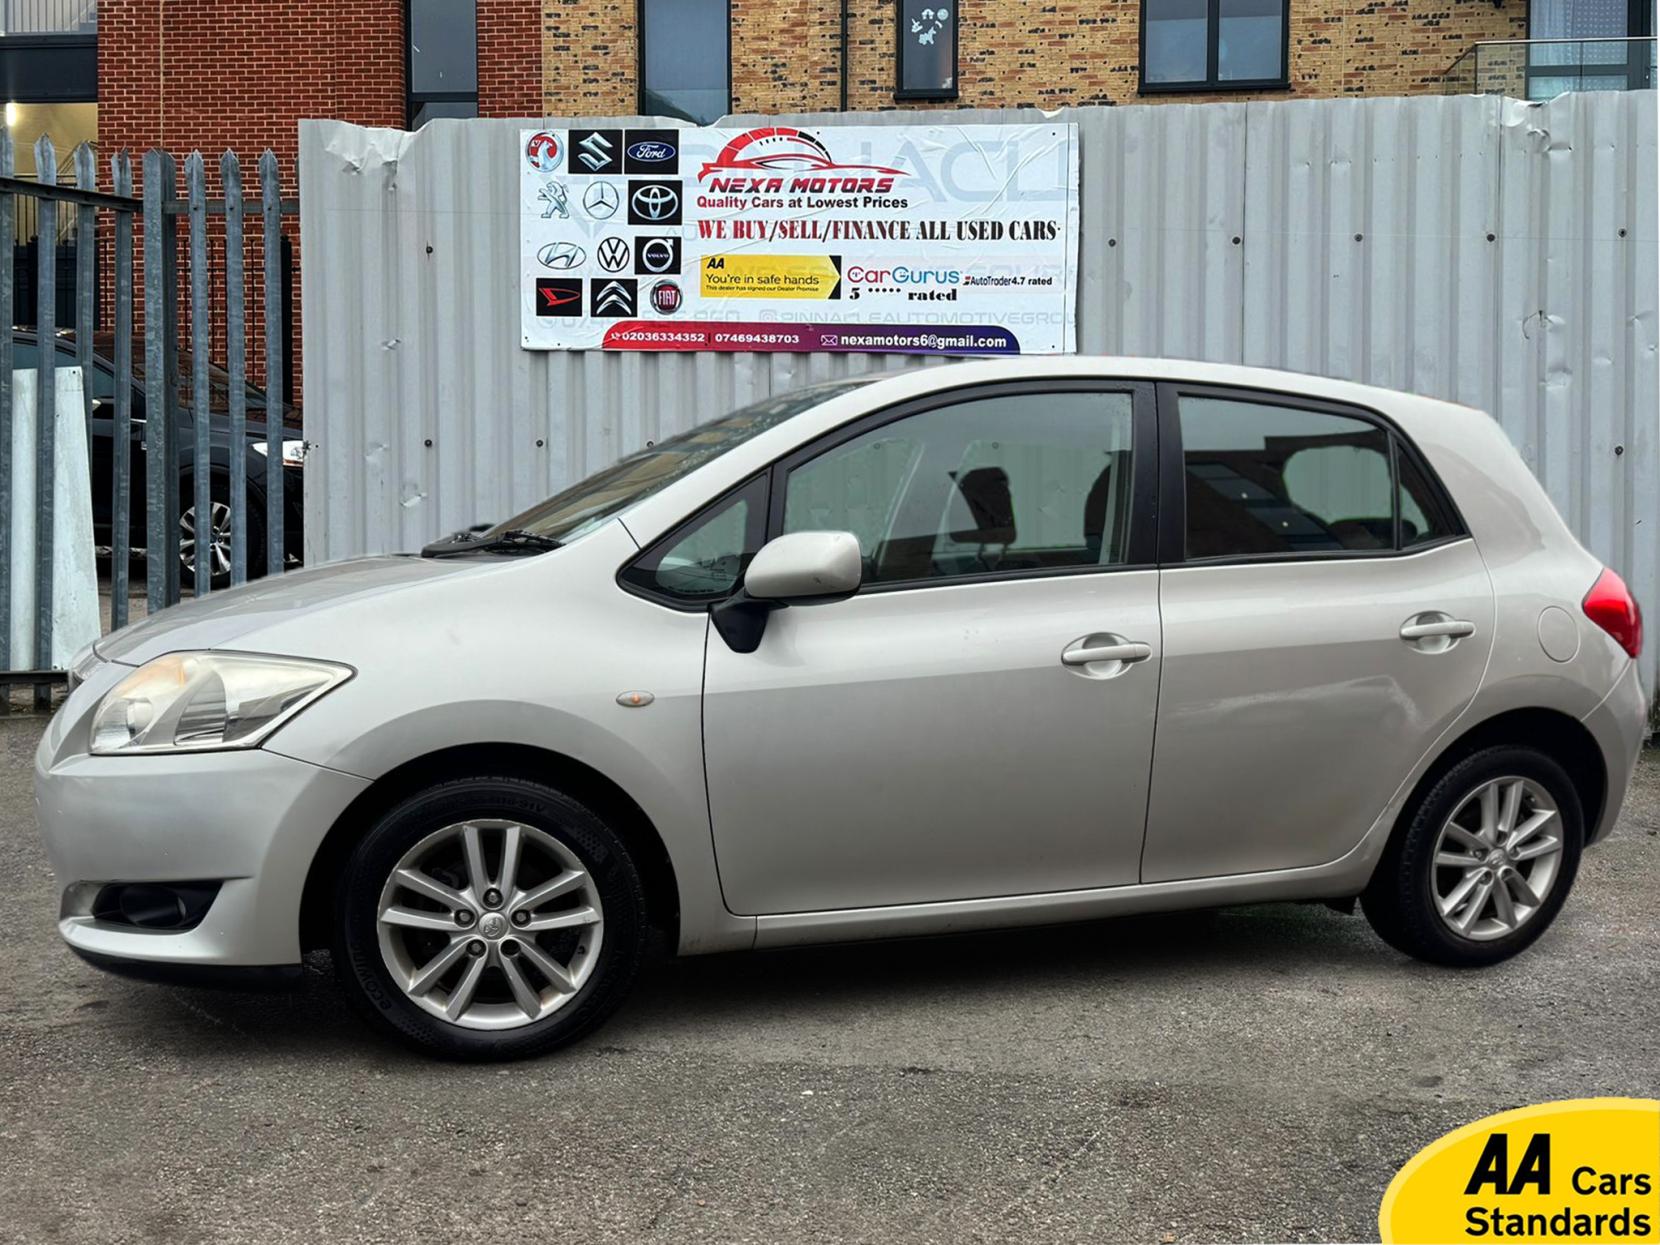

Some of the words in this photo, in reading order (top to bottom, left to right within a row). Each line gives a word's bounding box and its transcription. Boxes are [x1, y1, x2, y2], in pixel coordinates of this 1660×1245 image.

[636, 144, 666, 158] Ford
[709, 178, 783, 193] NEXA
[789, 178, 894, 193] MOTORS
[697, 195, 747, 210] Quality
[752, 196, 784, 208] Cars
[788, 197, 802, 208] at
[807, 196, 859, 208] Lowest
[863, 196, 908, 208] Prices
[698, 220, 727, 239] WE
[733, 220, 910, 242] BUY/SELL/FINANCE
[916, 220, 951, 240] ALL
[957, 220, 1004, 240] USED
[1008, 220, 1057, 240] CARS
[707, 258, 725, 269] AA
[705, 274, 741, 284] You're
[744, 274, 754, 284] in
[757, 274, 781, 285] safe
[784, 275, 820, 285] hands
[847, 266, 960, 284] CarGurus
[970, 275, 1011, 286] AutoTrader
[1011, 277, 1026, 286] 4.7
[1028, 277, 1053, 286] rated
[658, 290, 677, 305] FIAT
[849, 287, 861, 300] 5
[908, 288, 957, 301] rated
[622, 331, 706, 342] 02036334352
[715, 333, 799, 344] 07469438703
[841, 334, 1007, 349] nexamotors6@gmail.com
